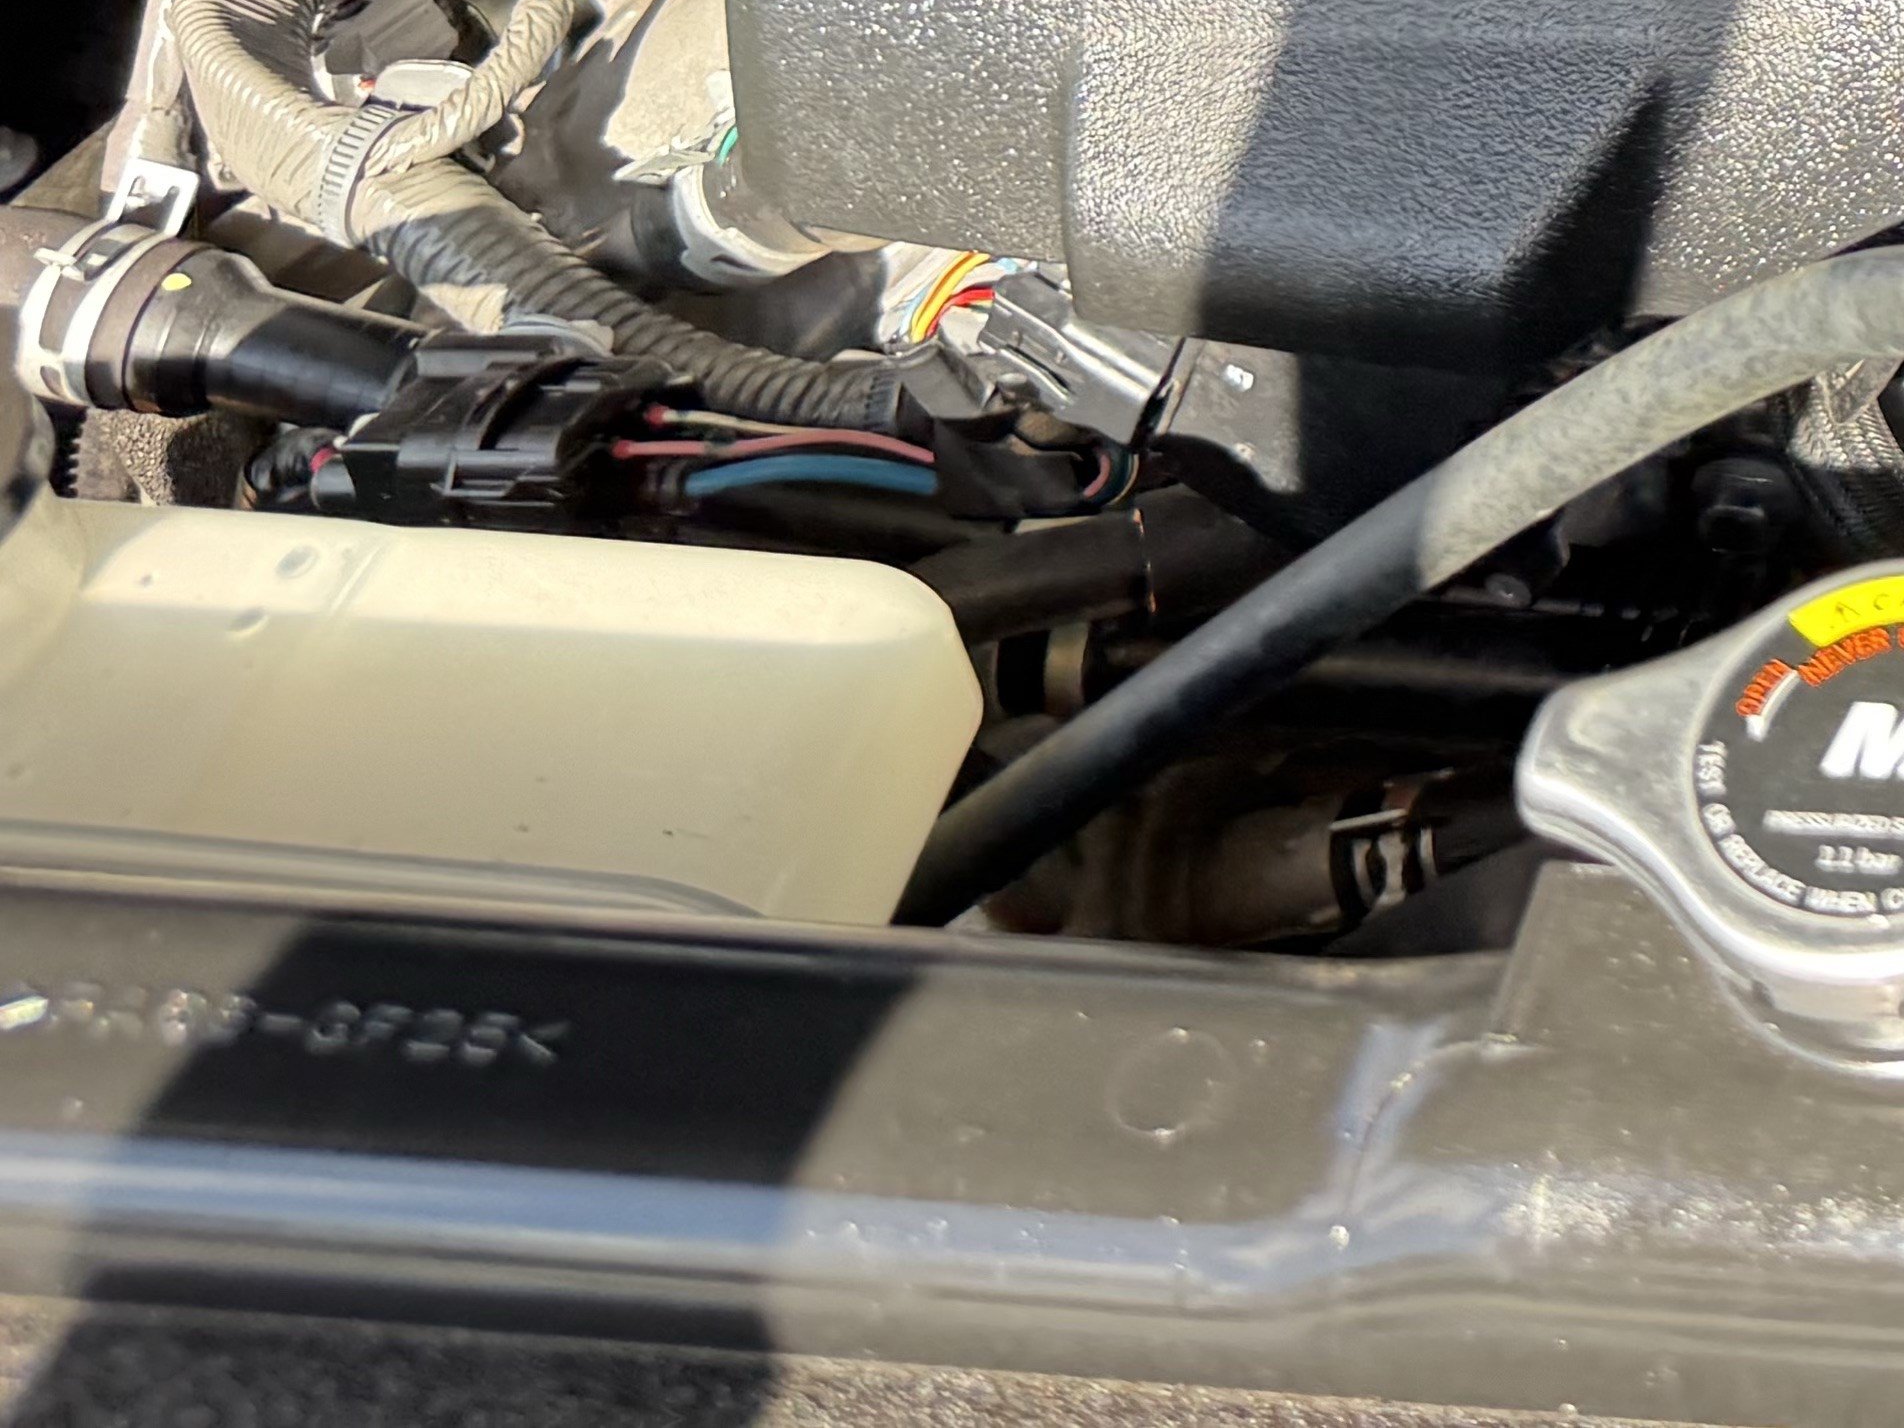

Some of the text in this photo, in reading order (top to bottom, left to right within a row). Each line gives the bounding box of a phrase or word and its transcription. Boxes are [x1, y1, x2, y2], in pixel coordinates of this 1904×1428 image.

[1694, 740, 1729, 800] TEST
[1718, 834, 1806, 906] REPLACE
[1804, 885, 1878, 915] WHEN
